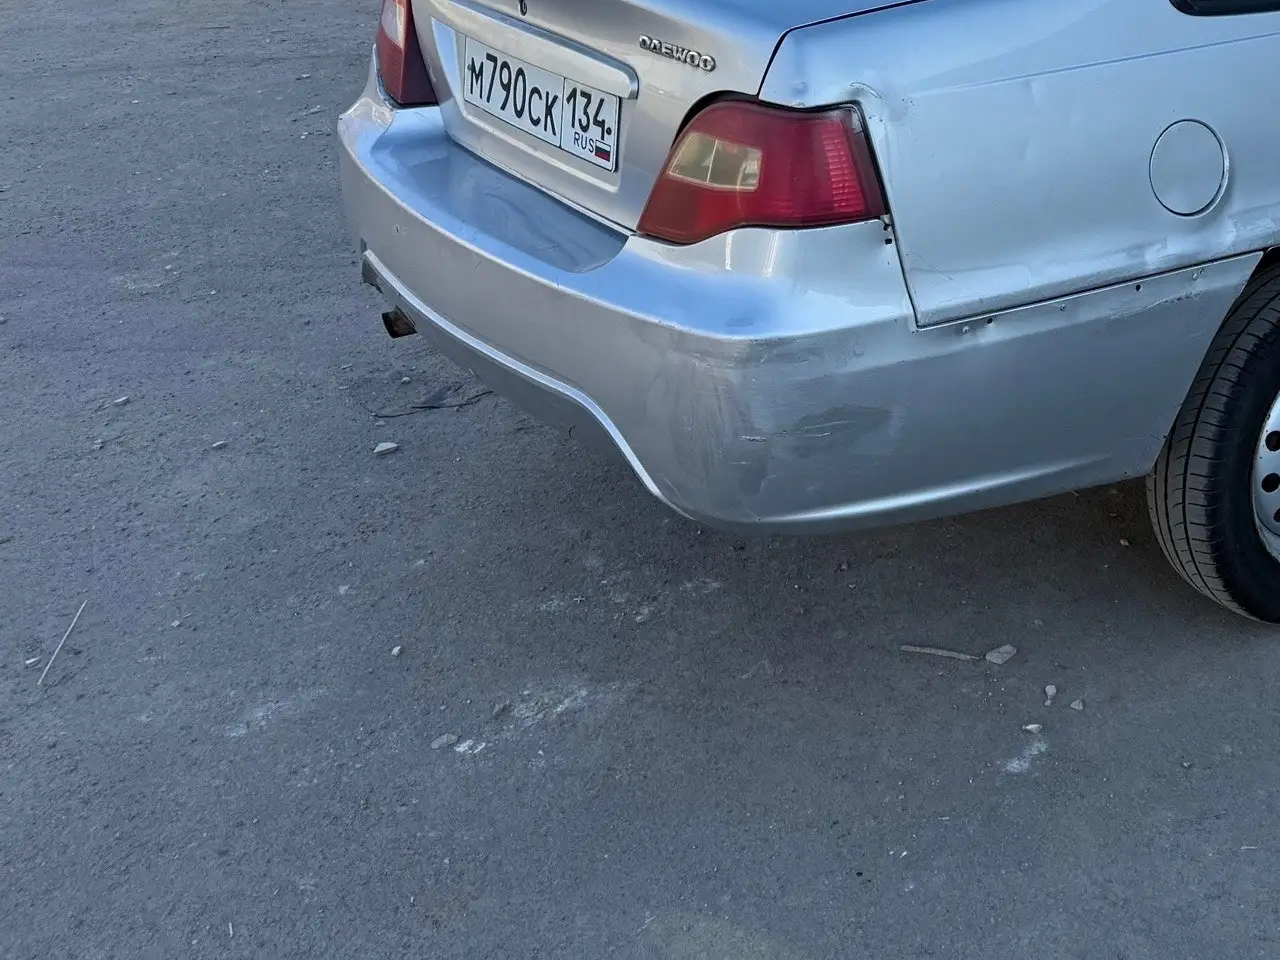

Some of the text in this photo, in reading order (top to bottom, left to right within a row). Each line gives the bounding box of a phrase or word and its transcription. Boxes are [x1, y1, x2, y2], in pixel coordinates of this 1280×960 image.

[639, 33, 716, 72] DAEWOO
[566, 87, 606, 141] 134
[573, 131, 595, 155] RUS
